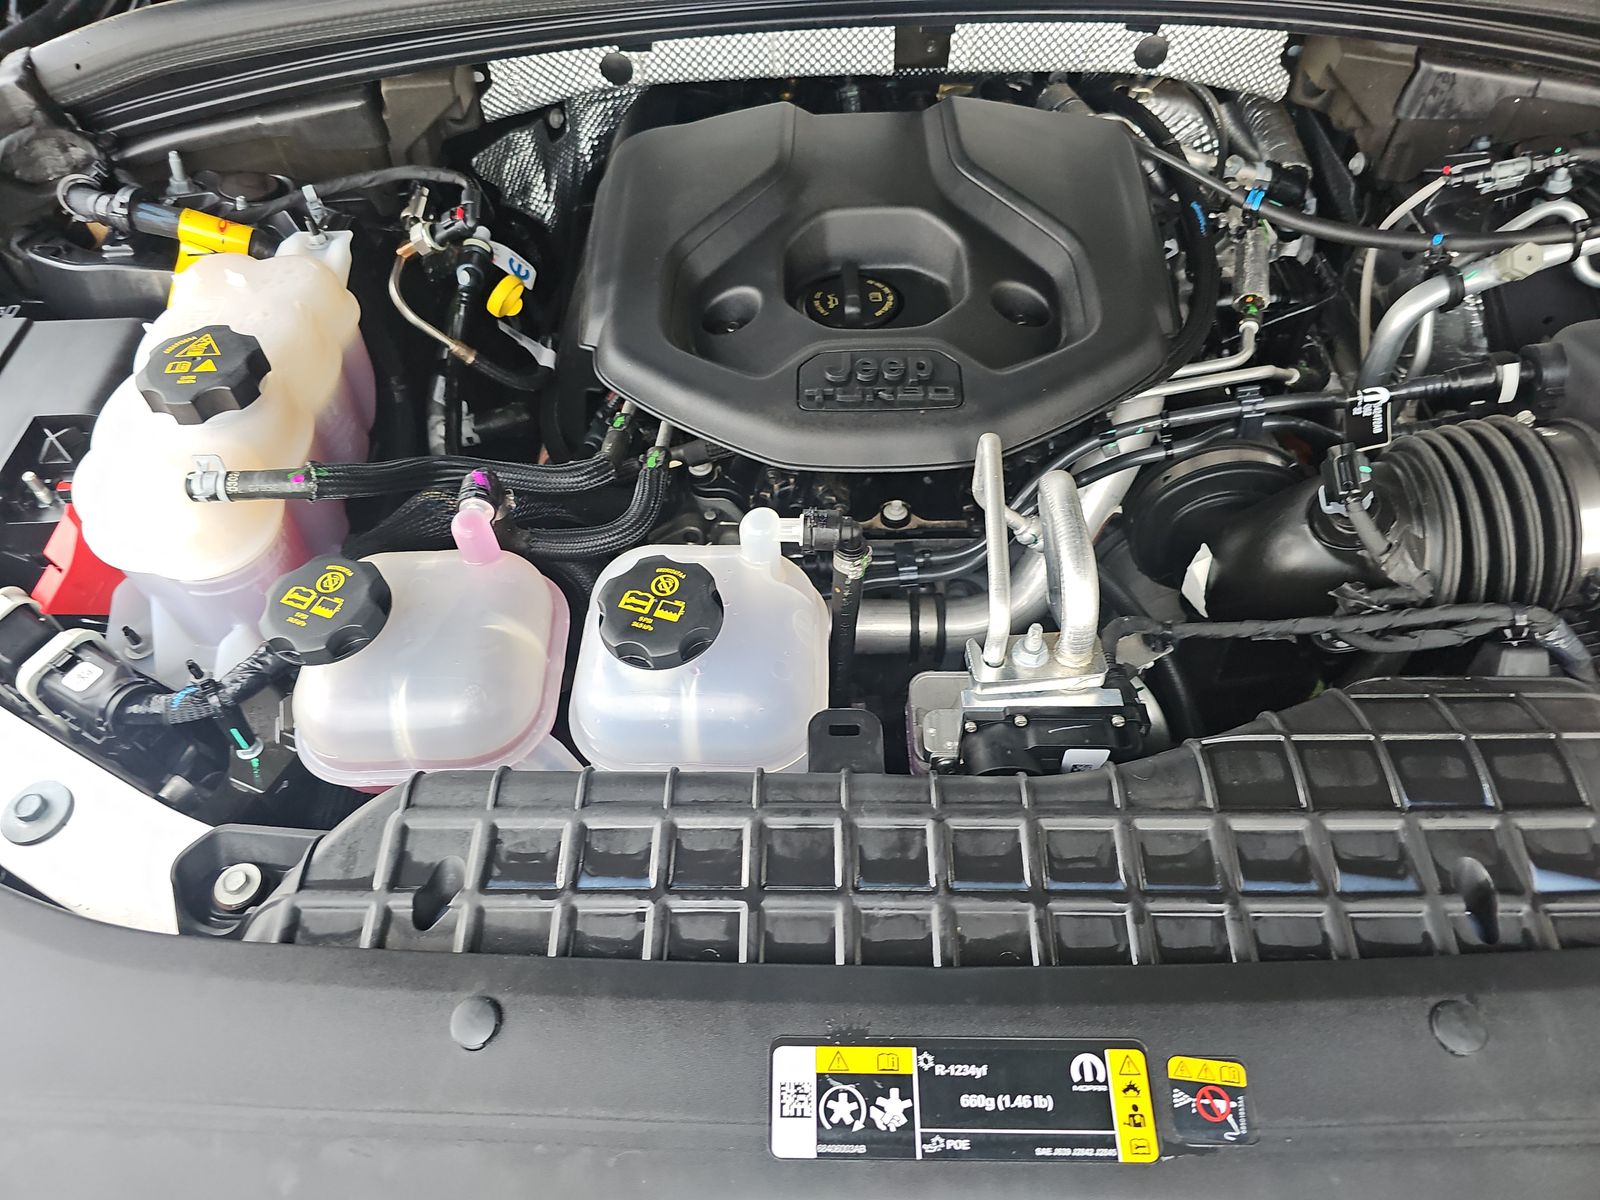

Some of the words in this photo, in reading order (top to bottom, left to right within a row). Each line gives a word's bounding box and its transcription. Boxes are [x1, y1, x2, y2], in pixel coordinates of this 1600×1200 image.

[824, 353, 934, 386] Jeep
[804, 387, 956, 405] TURBO
[934, 1064, 989, 1079] R-1234yf
[1071, 1084, 1108, 1092] MOPAR
[960, 1094, 996, 1111] 660g
[997, 1094, 1033, 1111] (1.46
[1034, 1094, 1055, 1112] lb)
[945, 1139, 971, 1151] POE
